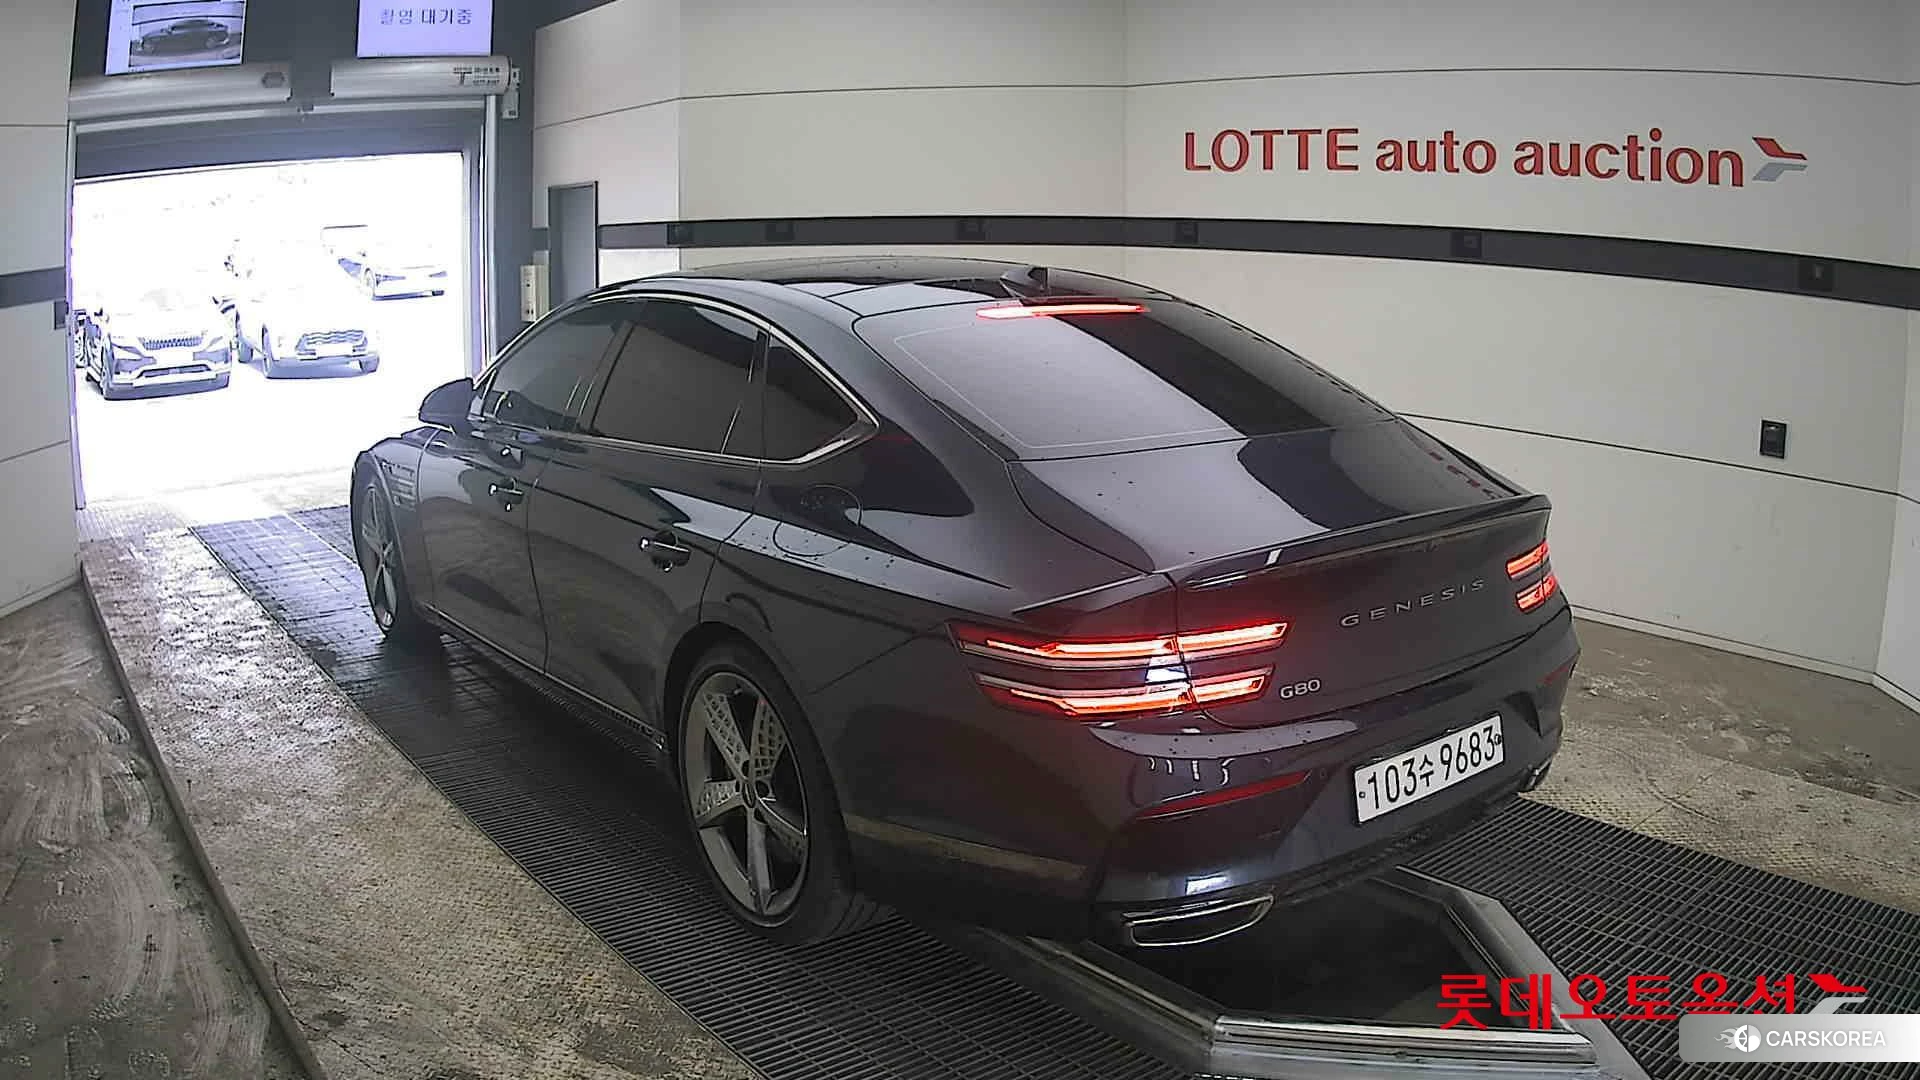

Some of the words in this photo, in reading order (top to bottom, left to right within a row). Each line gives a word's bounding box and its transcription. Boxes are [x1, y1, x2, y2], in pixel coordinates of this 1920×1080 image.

[421, 8, 473, 25] 대기중
[1184, 128, 1359, 172] LOTTE
[1376, 130, 1497, 174] auto
[1513, 127, 1744, 188] auction
[1340, 578, 1485, 627] GENESIS
[1279, 678, 1321, 699] G80
